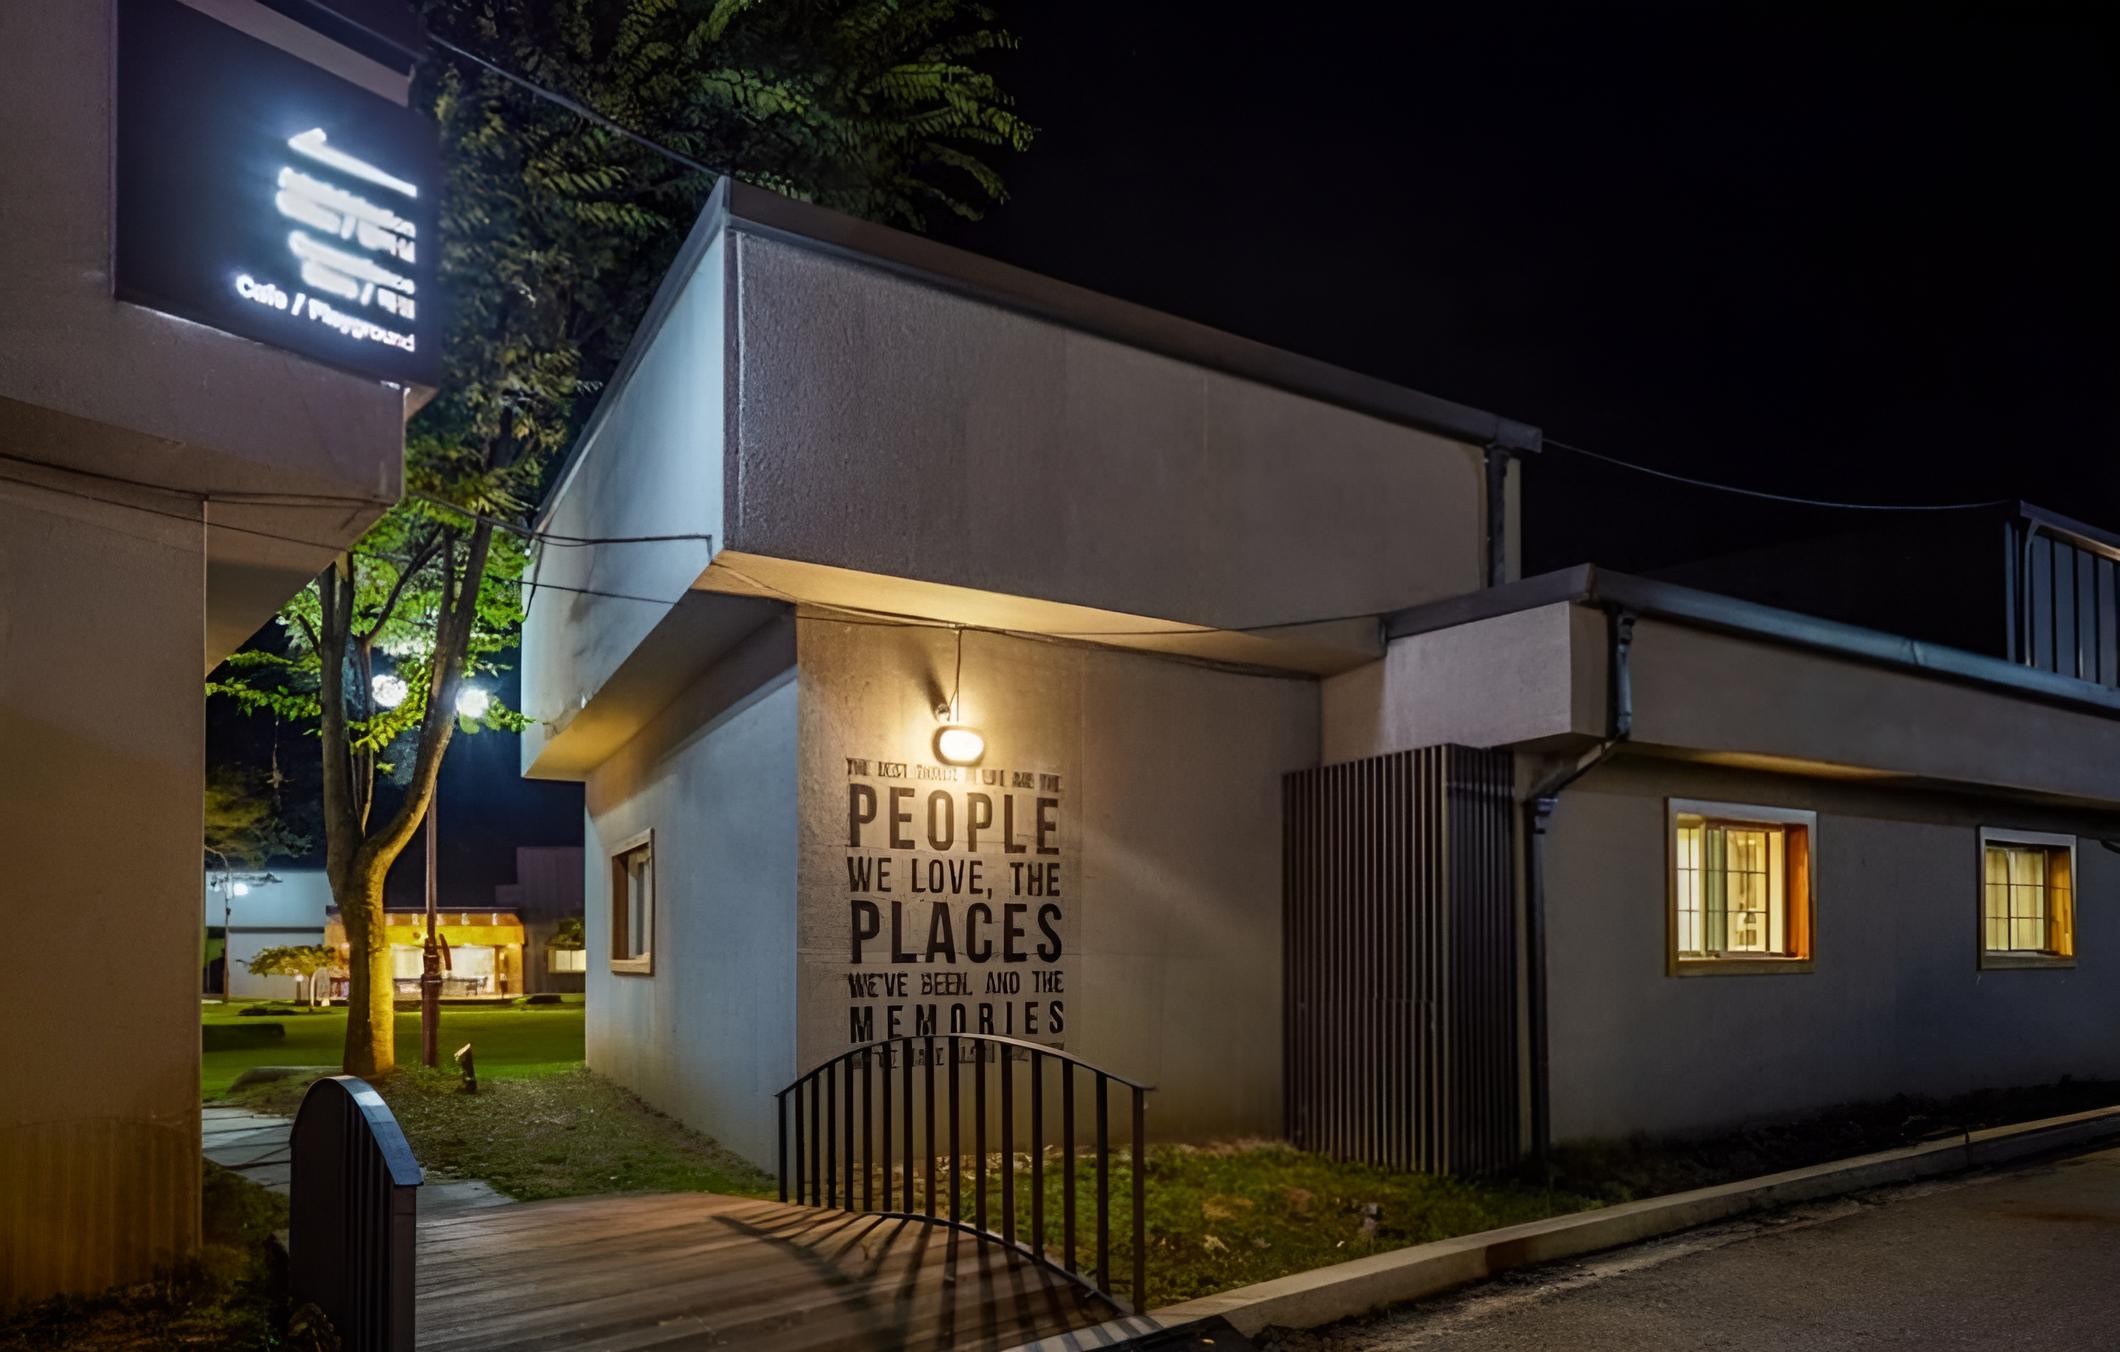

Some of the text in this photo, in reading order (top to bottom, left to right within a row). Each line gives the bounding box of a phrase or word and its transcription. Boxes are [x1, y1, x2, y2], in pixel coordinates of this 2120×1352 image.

[849, 783, 1060, 855] PEOPLE
[847, 856, 1061, 900] WE LOVE, THE
[850, 900, 1063, 964] PLACES
[985, 971, 1021, 995] AND
[1032, 970, 1064, 994] THE
[850, 1000, 1065, 1044] MEMORIES
